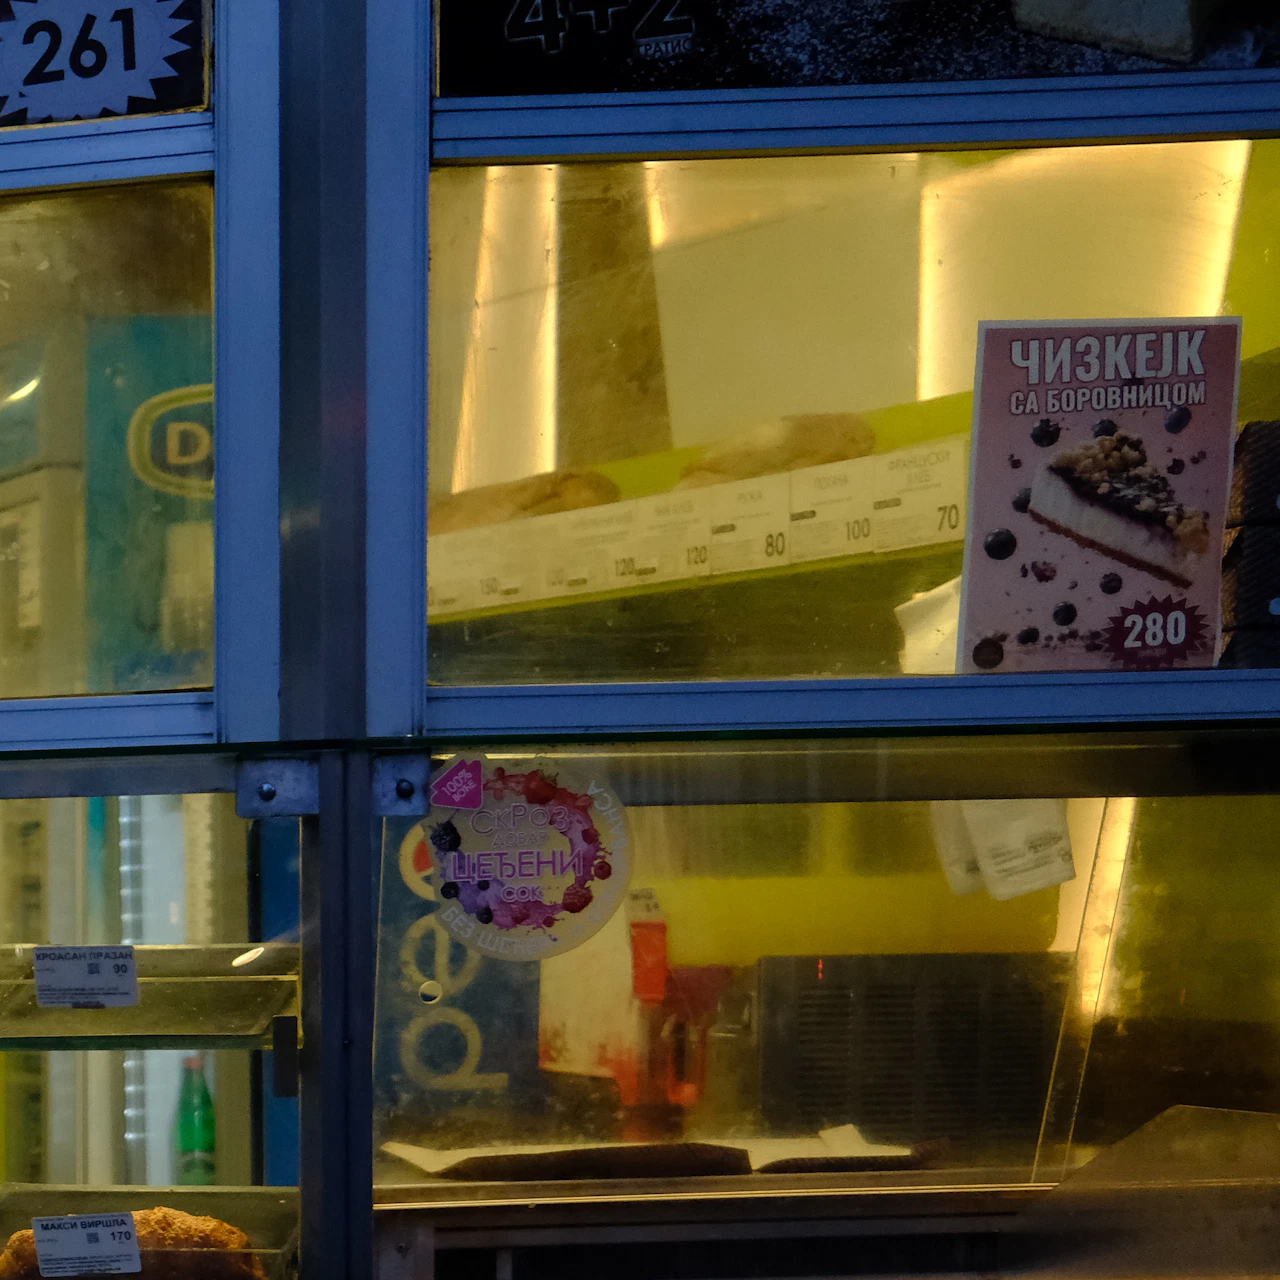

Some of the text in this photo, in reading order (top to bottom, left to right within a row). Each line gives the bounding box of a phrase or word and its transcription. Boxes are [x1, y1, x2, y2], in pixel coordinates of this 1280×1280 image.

[20, 6, 139, 86] 261
[1009, 329, 1208, 386] ЧИЗКЕЈК
[1009, 380, 1206, 415] СА БОРОВНИЦОМ
[844, 517, 871, 541] 100
[936, 504, 961, 531] 70
[686, 545, 708, 566] 120
[765, 531, 786, 557] 80
[614, 556, 635, 577] 120
[1122, 610, 1187, 648] 280
[441, 768, 473, 797] 100%
[451, 780, 478, 803] ВОЋЕ
[492, 832, 550, 848] ДОБАР
[451, 848, 585, 885] ЦЕЂЕНИ
[501, 885, 544, 903] СОК
[441, 905, 476, 938] БЕЗ
[35, 951, 133, 961] КРОАСАН ПРАЗАН
[112, 963, 129, 974] 90
[40, 1218, 127, 1231] МАКСИ ВИРШЛА
[109, 1230, 132, 1241] 170
